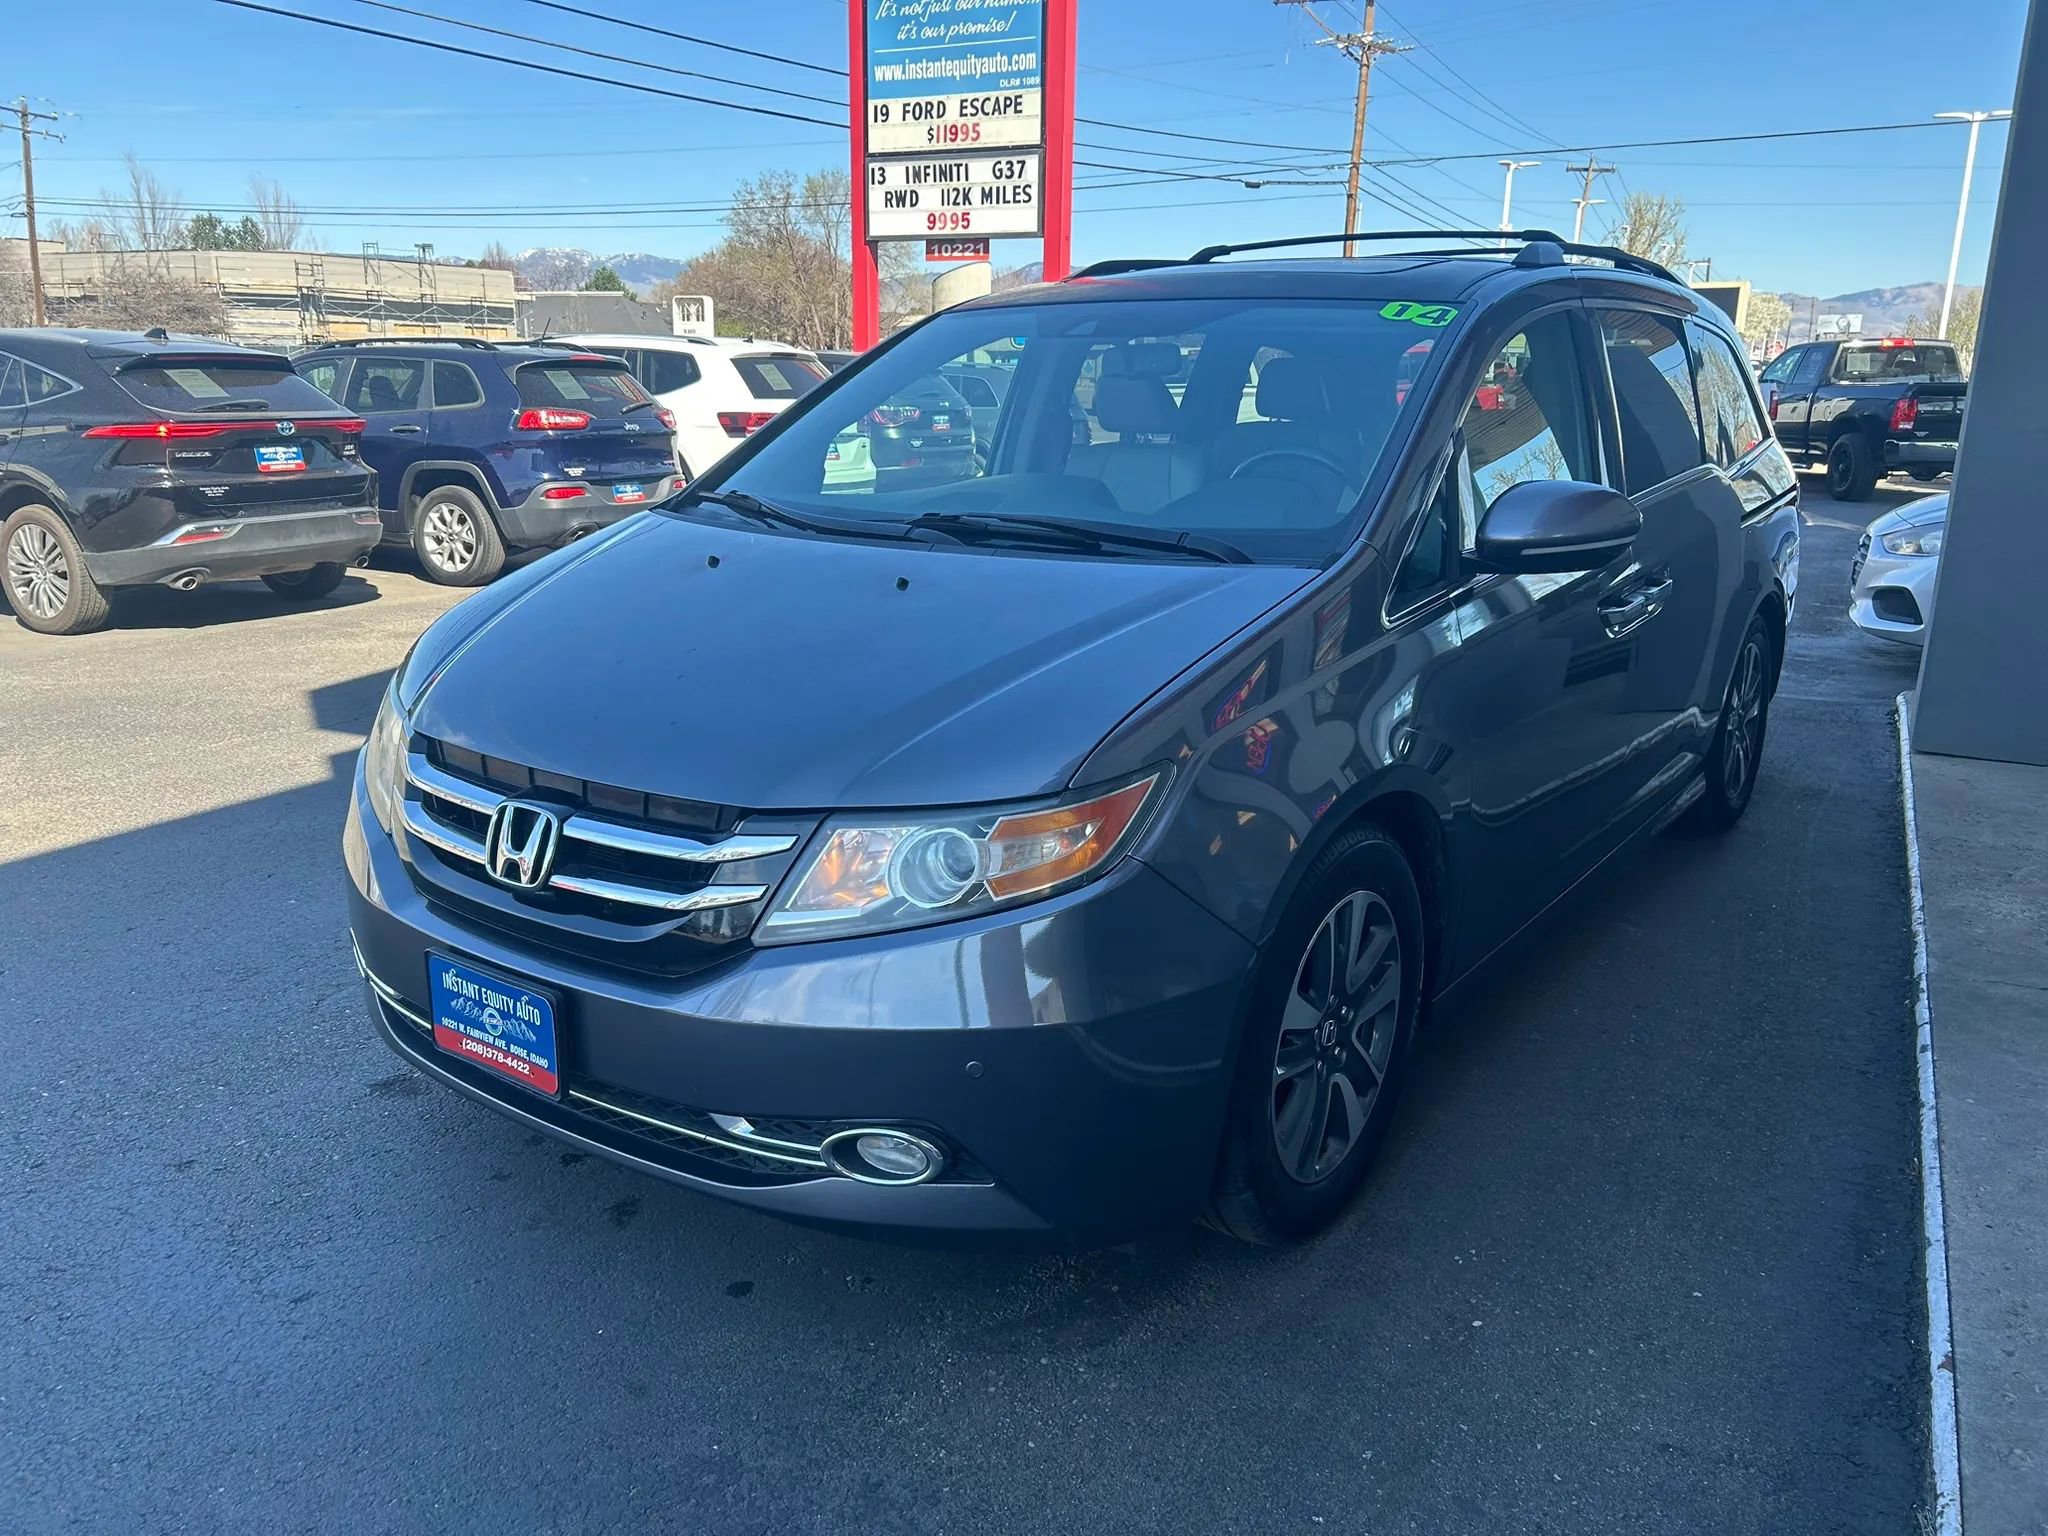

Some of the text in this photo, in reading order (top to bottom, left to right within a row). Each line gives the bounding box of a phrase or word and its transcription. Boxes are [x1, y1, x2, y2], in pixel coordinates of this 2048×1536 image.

[955, 0, 981, 11] our
[897, 10, 1017, 43] it's our promise!
[874, 51, 1037, 82] www.instantequityauto.com
[873, 95, 1023, 123] 19 FORD ESCAPE
[927, 122, 981, 144] $11995
[871, 160, 1026, 185] 13 INFINITI G37
[884, 184, 1032, 208] RWD 112K MILES
[927, 212, 971, 231] 9995
[931, 242, 984, 257] 10221
[1387, 303, 1455, 325] 14
[624, 422, 640, 432] Jeep
[442, 971, 541, 1026] INSTANT EQUITY AUTO
[462, 1037, 530, 1075] (208)378-4422
[466, 1026, 494, 1045] FAIRVIEW
[494, 1037, 508, 1050] AVE.
[510, 1044, 529, 1062] BOISE,
[530, 1052, 549, 1069] IDAHO
